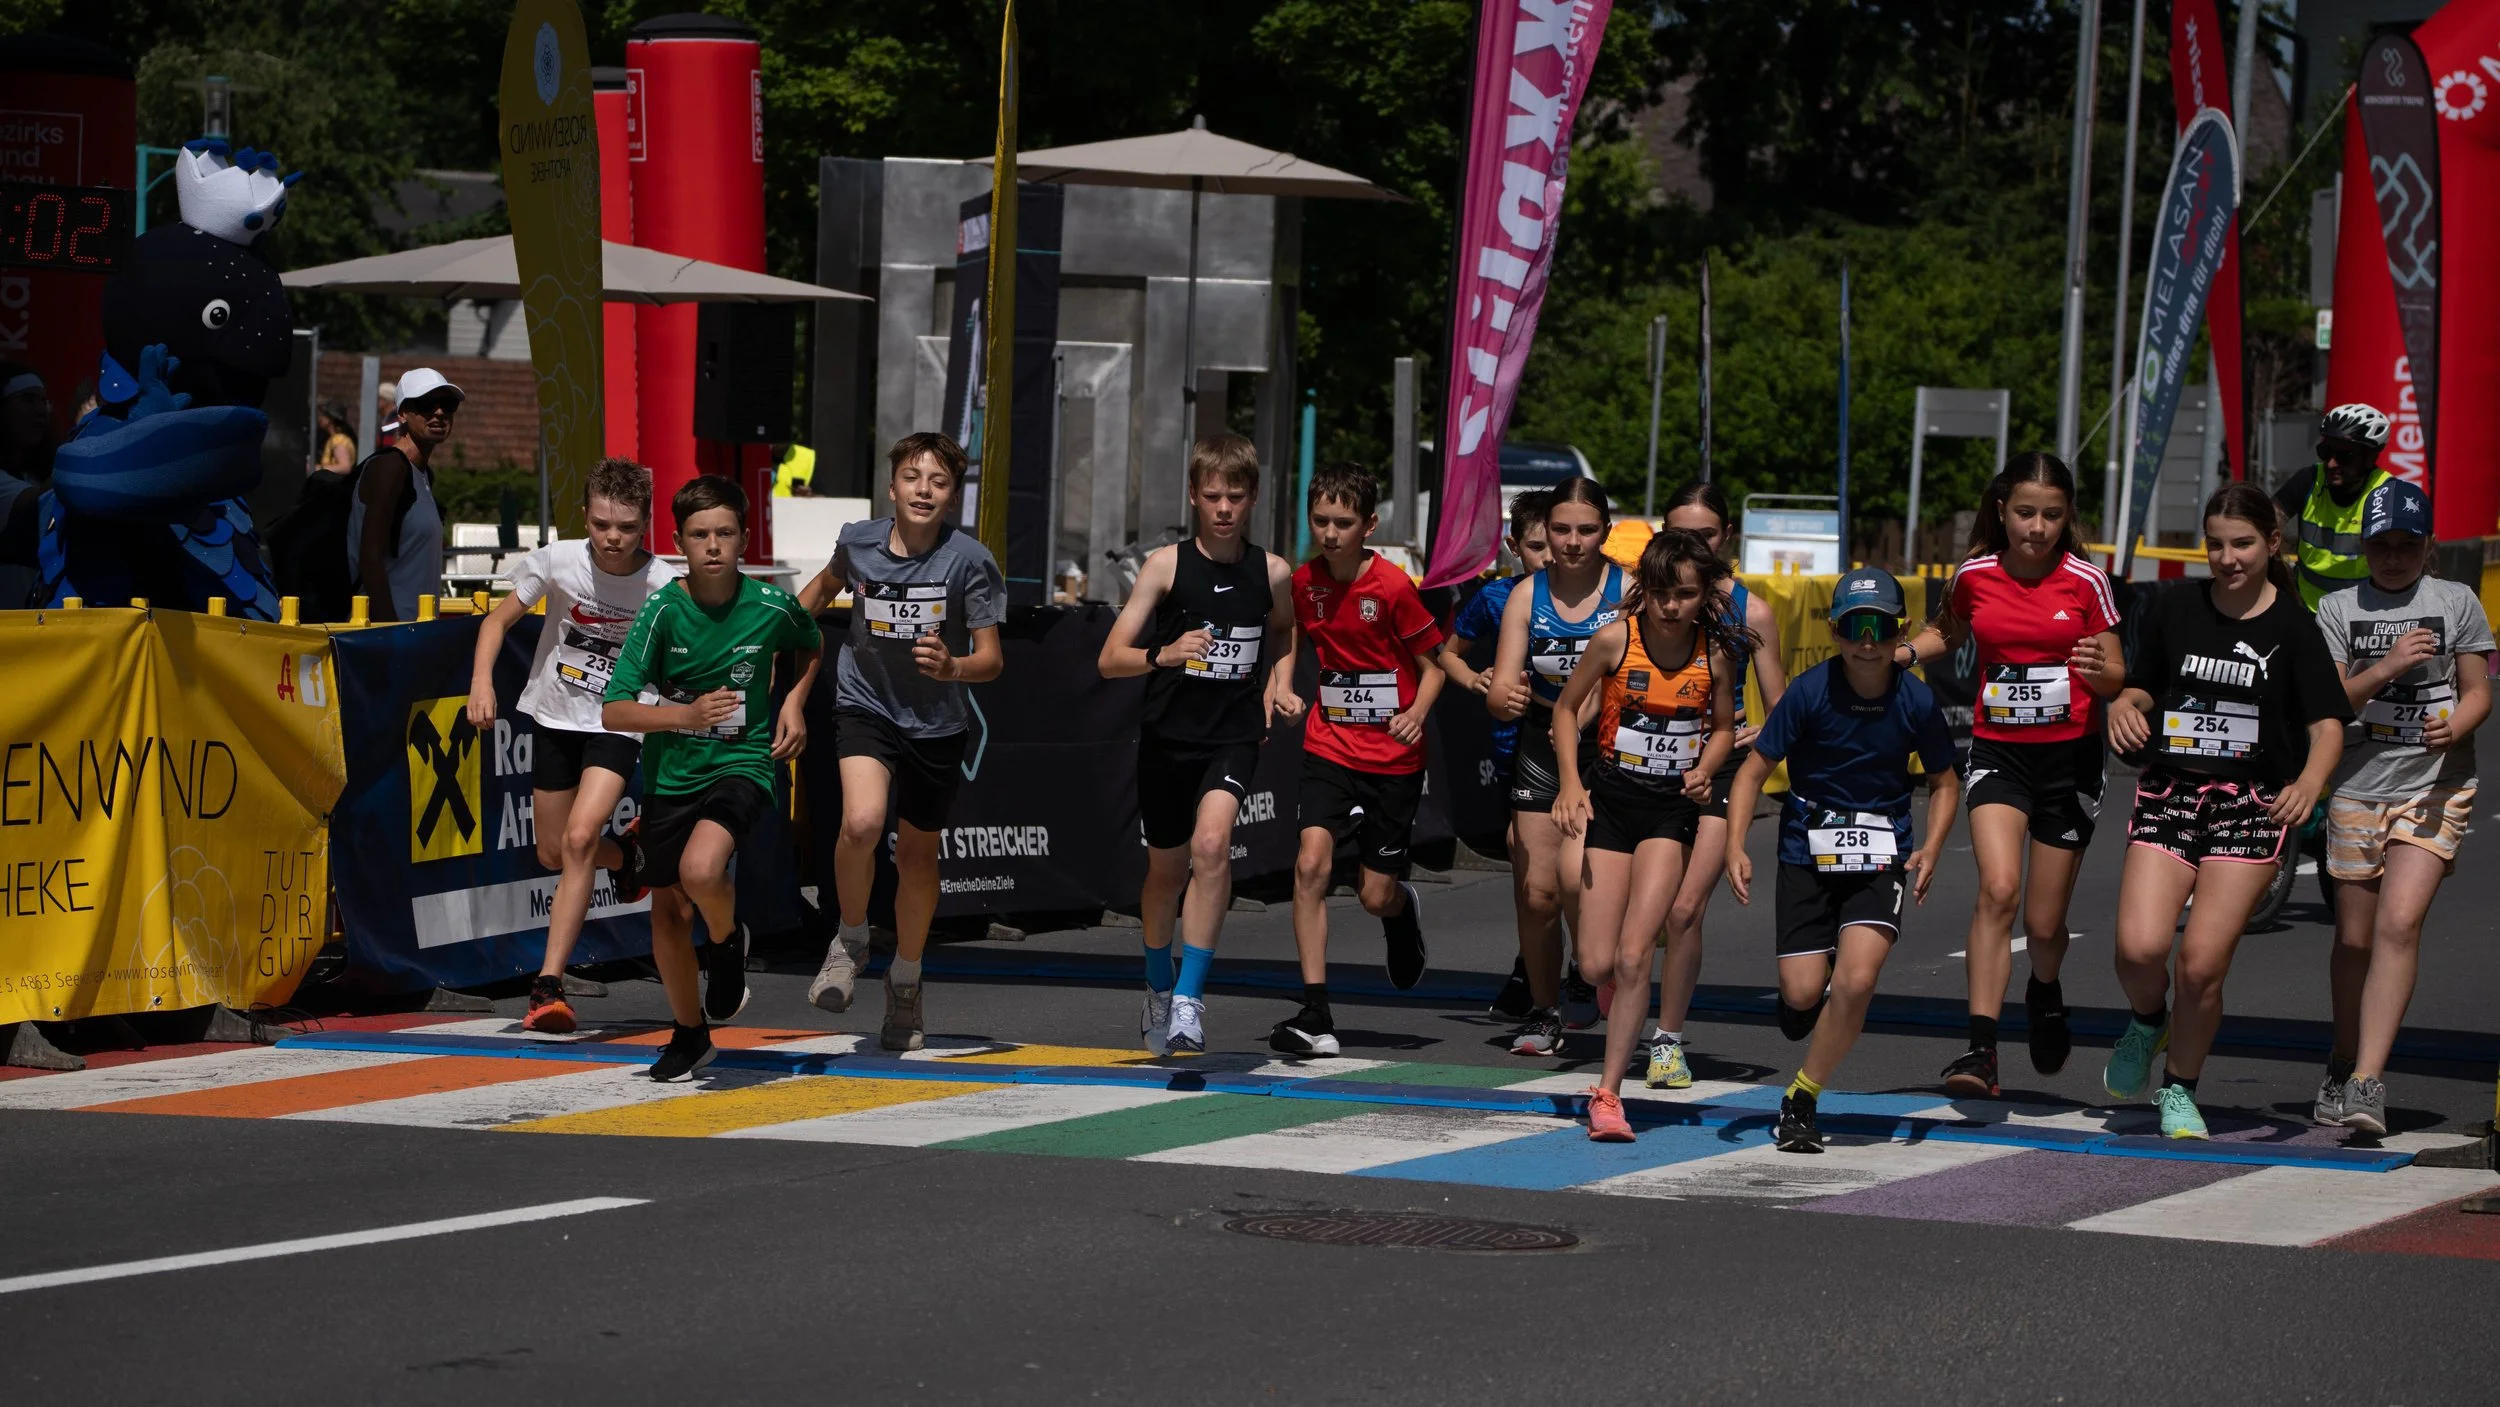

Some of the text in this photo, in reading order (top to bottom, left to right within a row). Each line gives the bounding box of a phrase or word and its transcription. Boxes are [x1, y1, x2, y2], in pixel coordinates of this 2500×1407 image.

[2149, 147, 2204, 344] MELASAN
[2164, 333, 2187, 386] alles
[2178, 289, 2201, 334] drin
[2191, 258, 2209, 295] für
[2204, 205, 2228, 261] dich!
[889, 603, 921, 619] 162
[670, 646, 689, 654] JAKO
[1209, 642, 1241, 659] 239
[585, 654, 616, 676] 235
[2180, 653, 2256, 688] PUMA
[1343, 689, 1374, 704] 264
[2008, 685, 2042, 702] 255
[2193, 715, 2230, 734] 254
[1644, 735, 1679, 754] 164
[953, 825, 1050, 858] STREICHER
[1834, 830, 1869, 848] 258
[264, 850, 314, 891] TUT
[940, 875, 1015, 894] #ErreicheDeineZiele
[258, 893, 312, 934] DIR
[257, 936, 313, 978] GUT
[20, 973, 51, 991] 4863
